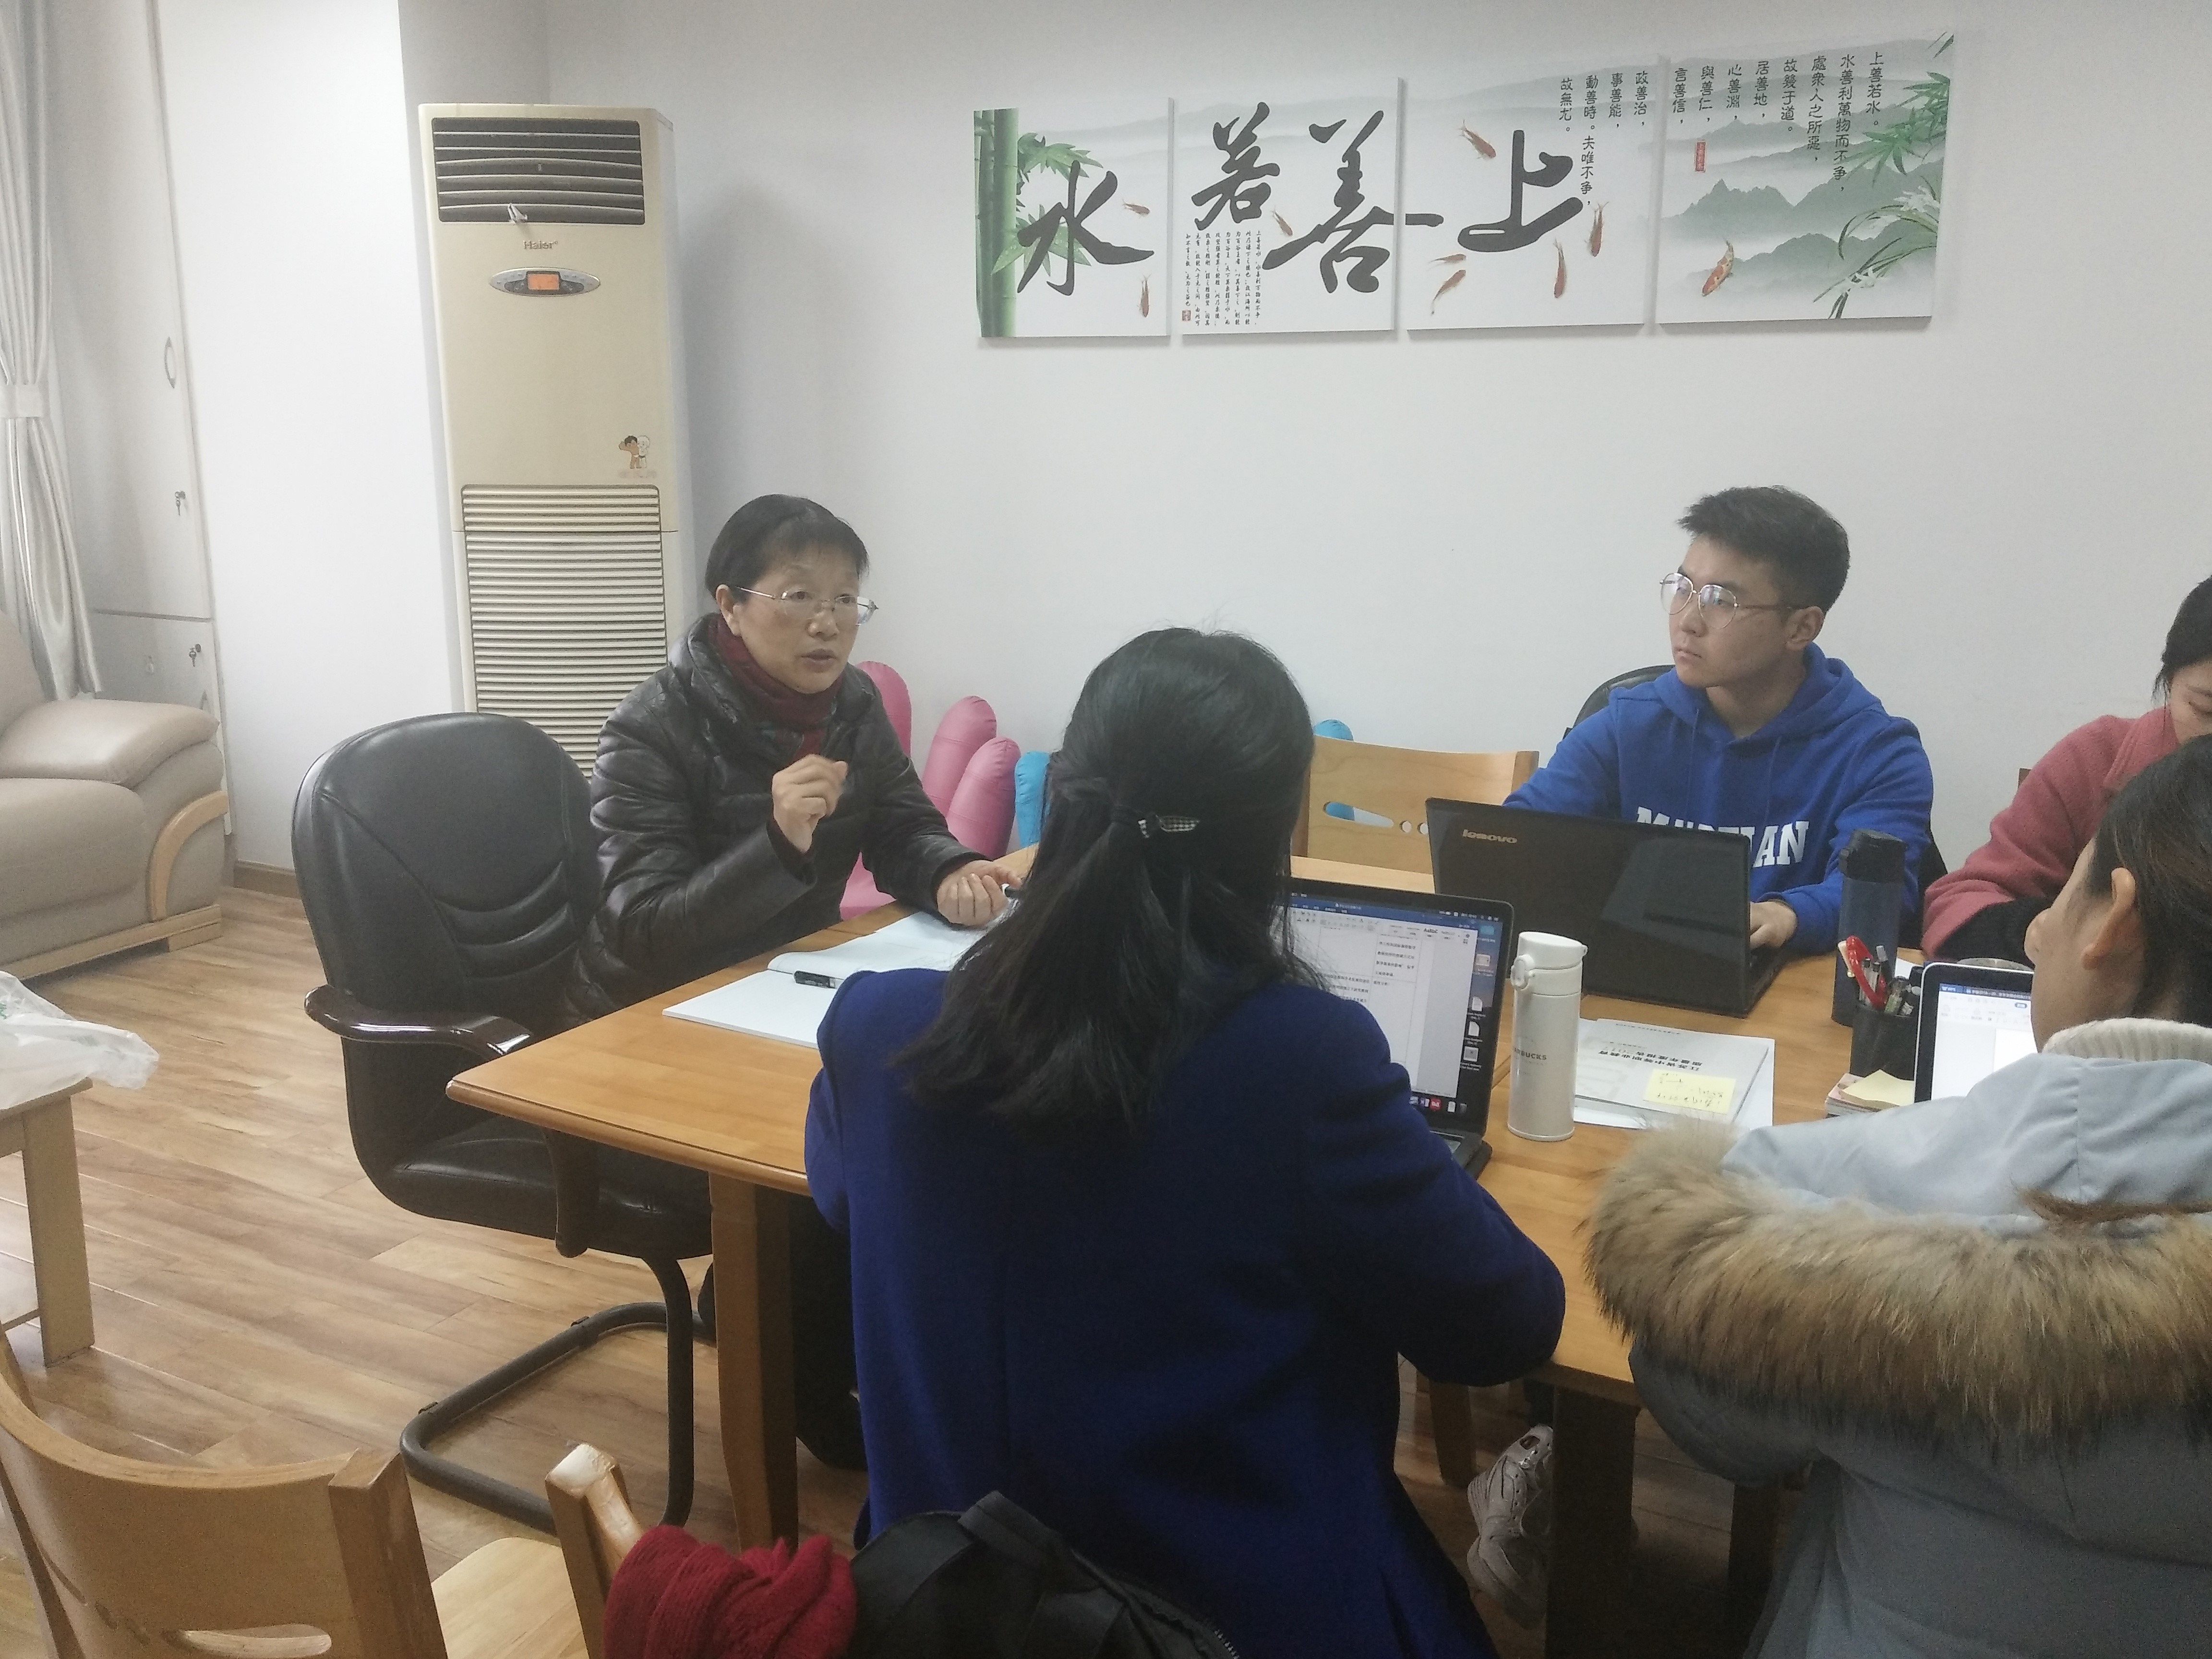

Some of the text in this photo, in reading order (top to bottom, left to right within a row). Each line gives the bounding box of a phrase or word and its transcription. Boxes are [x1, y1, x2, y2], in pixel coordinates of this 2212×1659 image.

[1866, 51, 1884, 126] 上善若水。
[1462, 829, 1517, 843] lenovo
